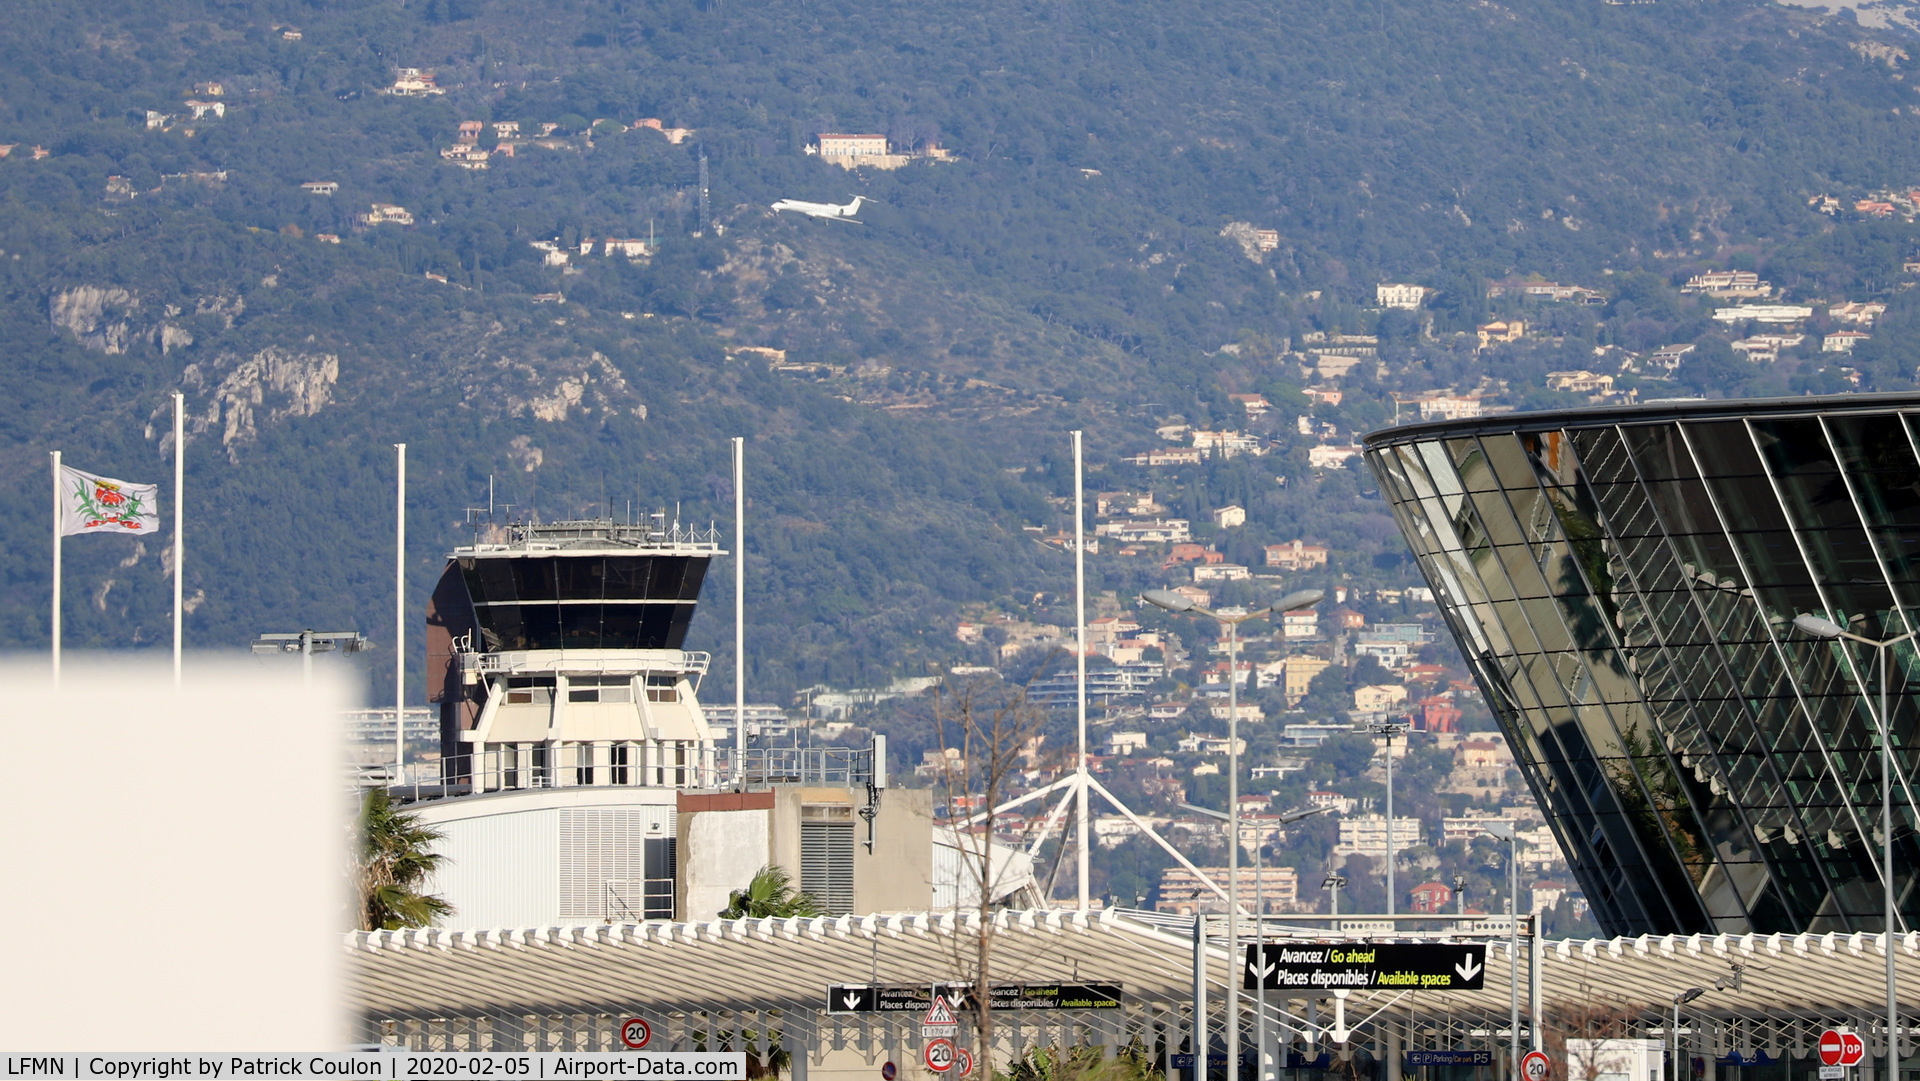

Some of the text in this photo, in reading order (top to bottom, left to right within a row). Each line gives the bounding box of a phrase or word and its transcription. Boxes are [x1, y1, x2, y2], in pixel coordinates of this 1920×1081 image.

[1279, 948, 1322, 963] Avancez
[1330, 949, 1345, 963] Go
[1346, 949, 1375, 963] ahead
[1277, 969, 1309, 985] Places
[1311, 969, 1368, 988] disponibles
[1377, 971, 1419, 985] Available
[1420, 973, 1451, 988] spaces
[1024, 987, 1036, 996] Go
[1036, 987, 1059, 996] ahead
[880, 1000, 904, 1009] Places
[1010, 998, 1054, 1010] disponibles
[1060, 998, 1093, 1007] Available
[1093, 999, 1117, 1009] spaces
[627, 1027, 646, 1040] 20
[932, 1048, 951, 1062] 20
[1844, 1043, 1861, 1055] OP
[1473, 1053, 1489, 1064] P5
[1529, 1064, 1544, 1075] 20
